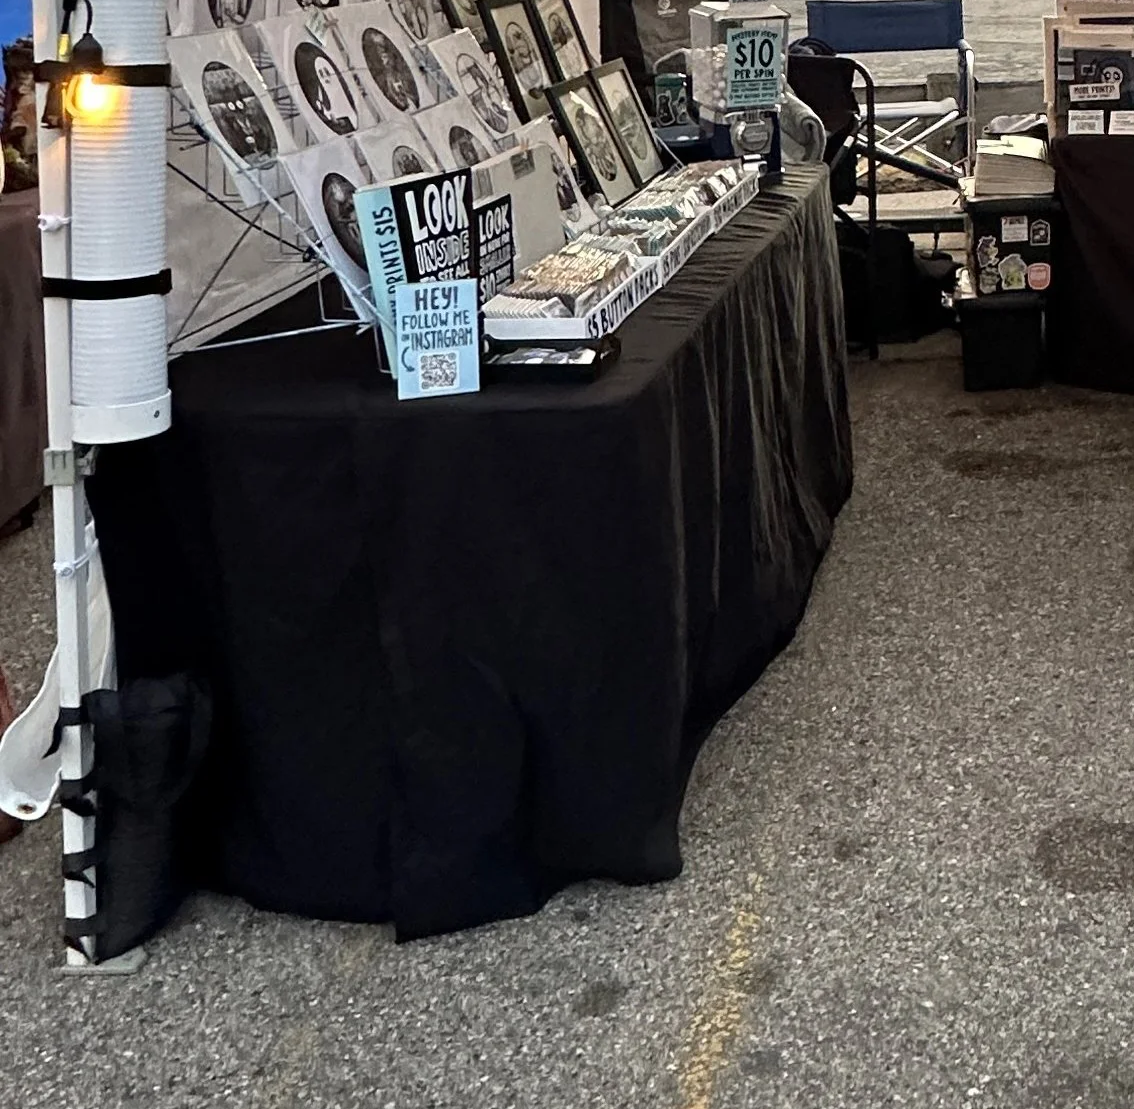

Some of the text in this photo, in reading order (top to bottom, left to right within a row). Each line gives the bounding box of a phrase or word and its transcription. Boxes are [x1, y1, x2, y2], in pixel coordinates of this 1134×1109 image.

[734, 38, 774, 68] $10
[734, 68, 774, 79] PER SPIN
[373, 206, 397, 236] $15
[404, 175, 470, 243] LOOK
[478, 203, 510, 244] LOOK
[414, 230, 470, 276] INSIDE
[455, 261, 471, 279] ALL
[414, 285, 459, 312] HEY!
[479, 272, 496, 303] $10
[600, 287, 634, 334] BUTTON
[633, 264, 660, 304] PACKS
[401, 313, 449, 332] FOLLOW
[452, 310, 470, 326] ME
[411, 327, 474, 351] INSTAGRAM
